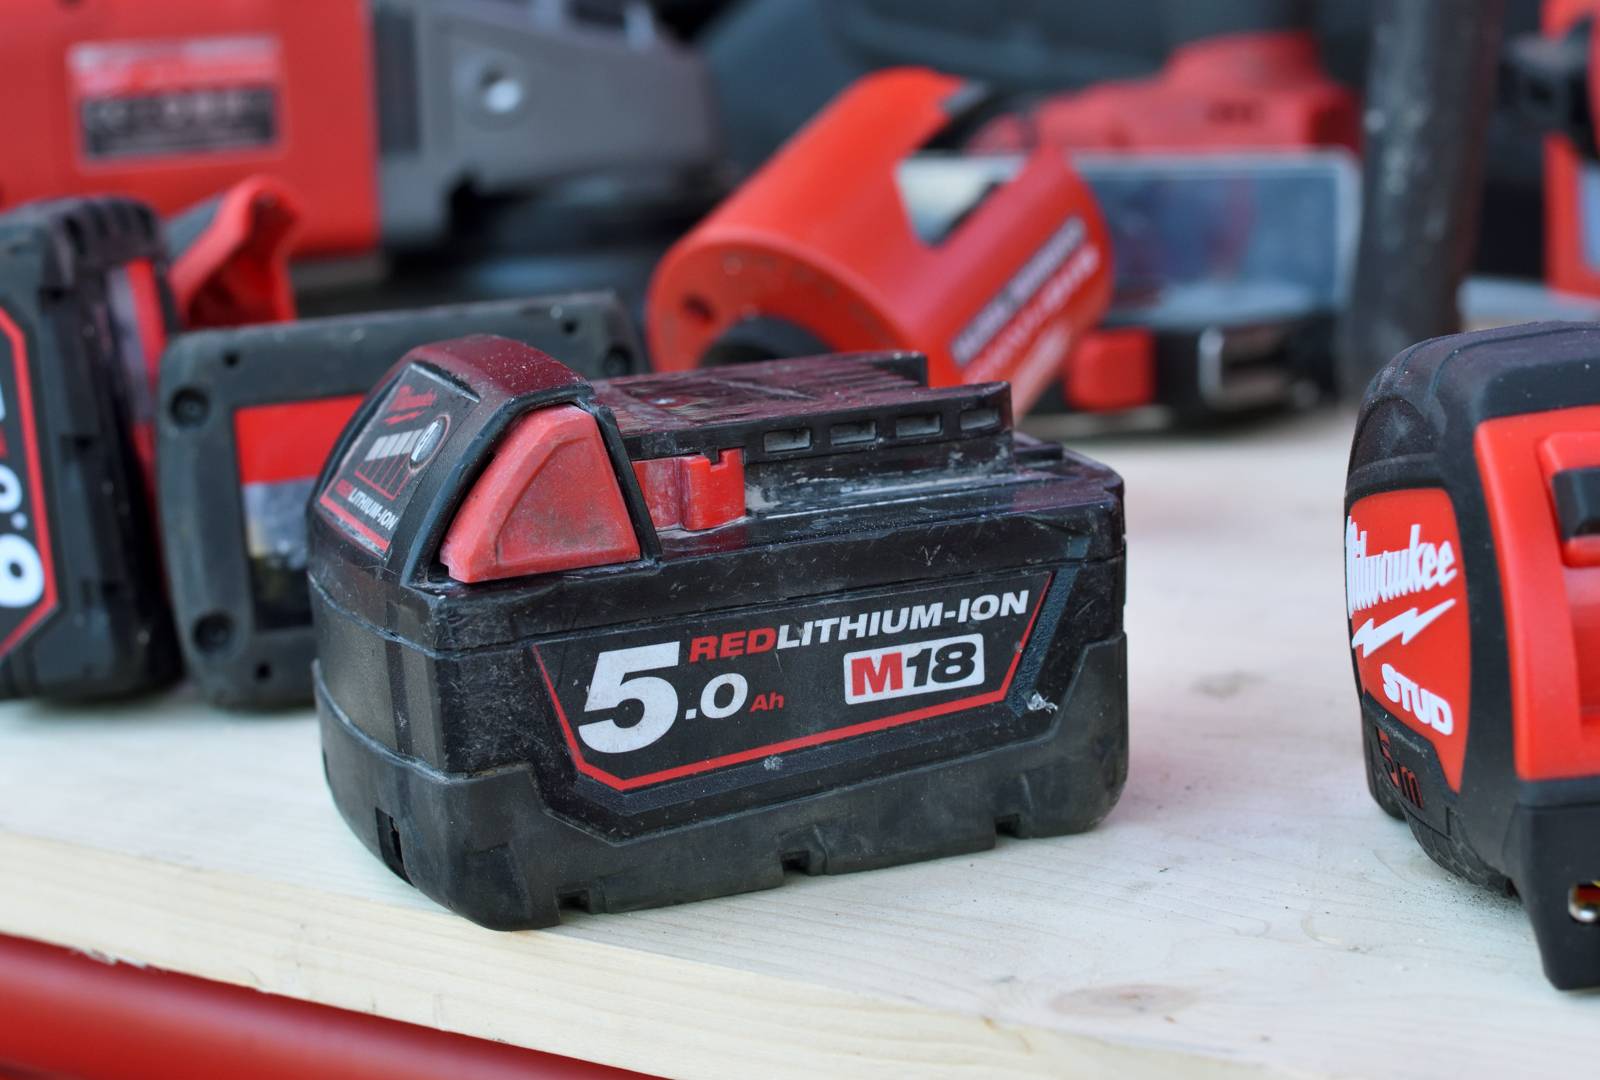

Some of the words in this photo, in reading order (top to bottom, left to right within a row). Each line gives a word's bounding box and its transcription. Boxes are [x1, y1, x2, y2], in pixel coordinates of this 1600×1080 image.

[334, 479, 400, 530] LITHIUM-ION
[688, 589, 1030, 664] REDLITHIUM-ION
[578, 641, 749, 755] 5.0
[749, 691, 785, 714] Ah
[851, 640, 977, 697] M18
[1381, 663, 1454, 736] STUD
